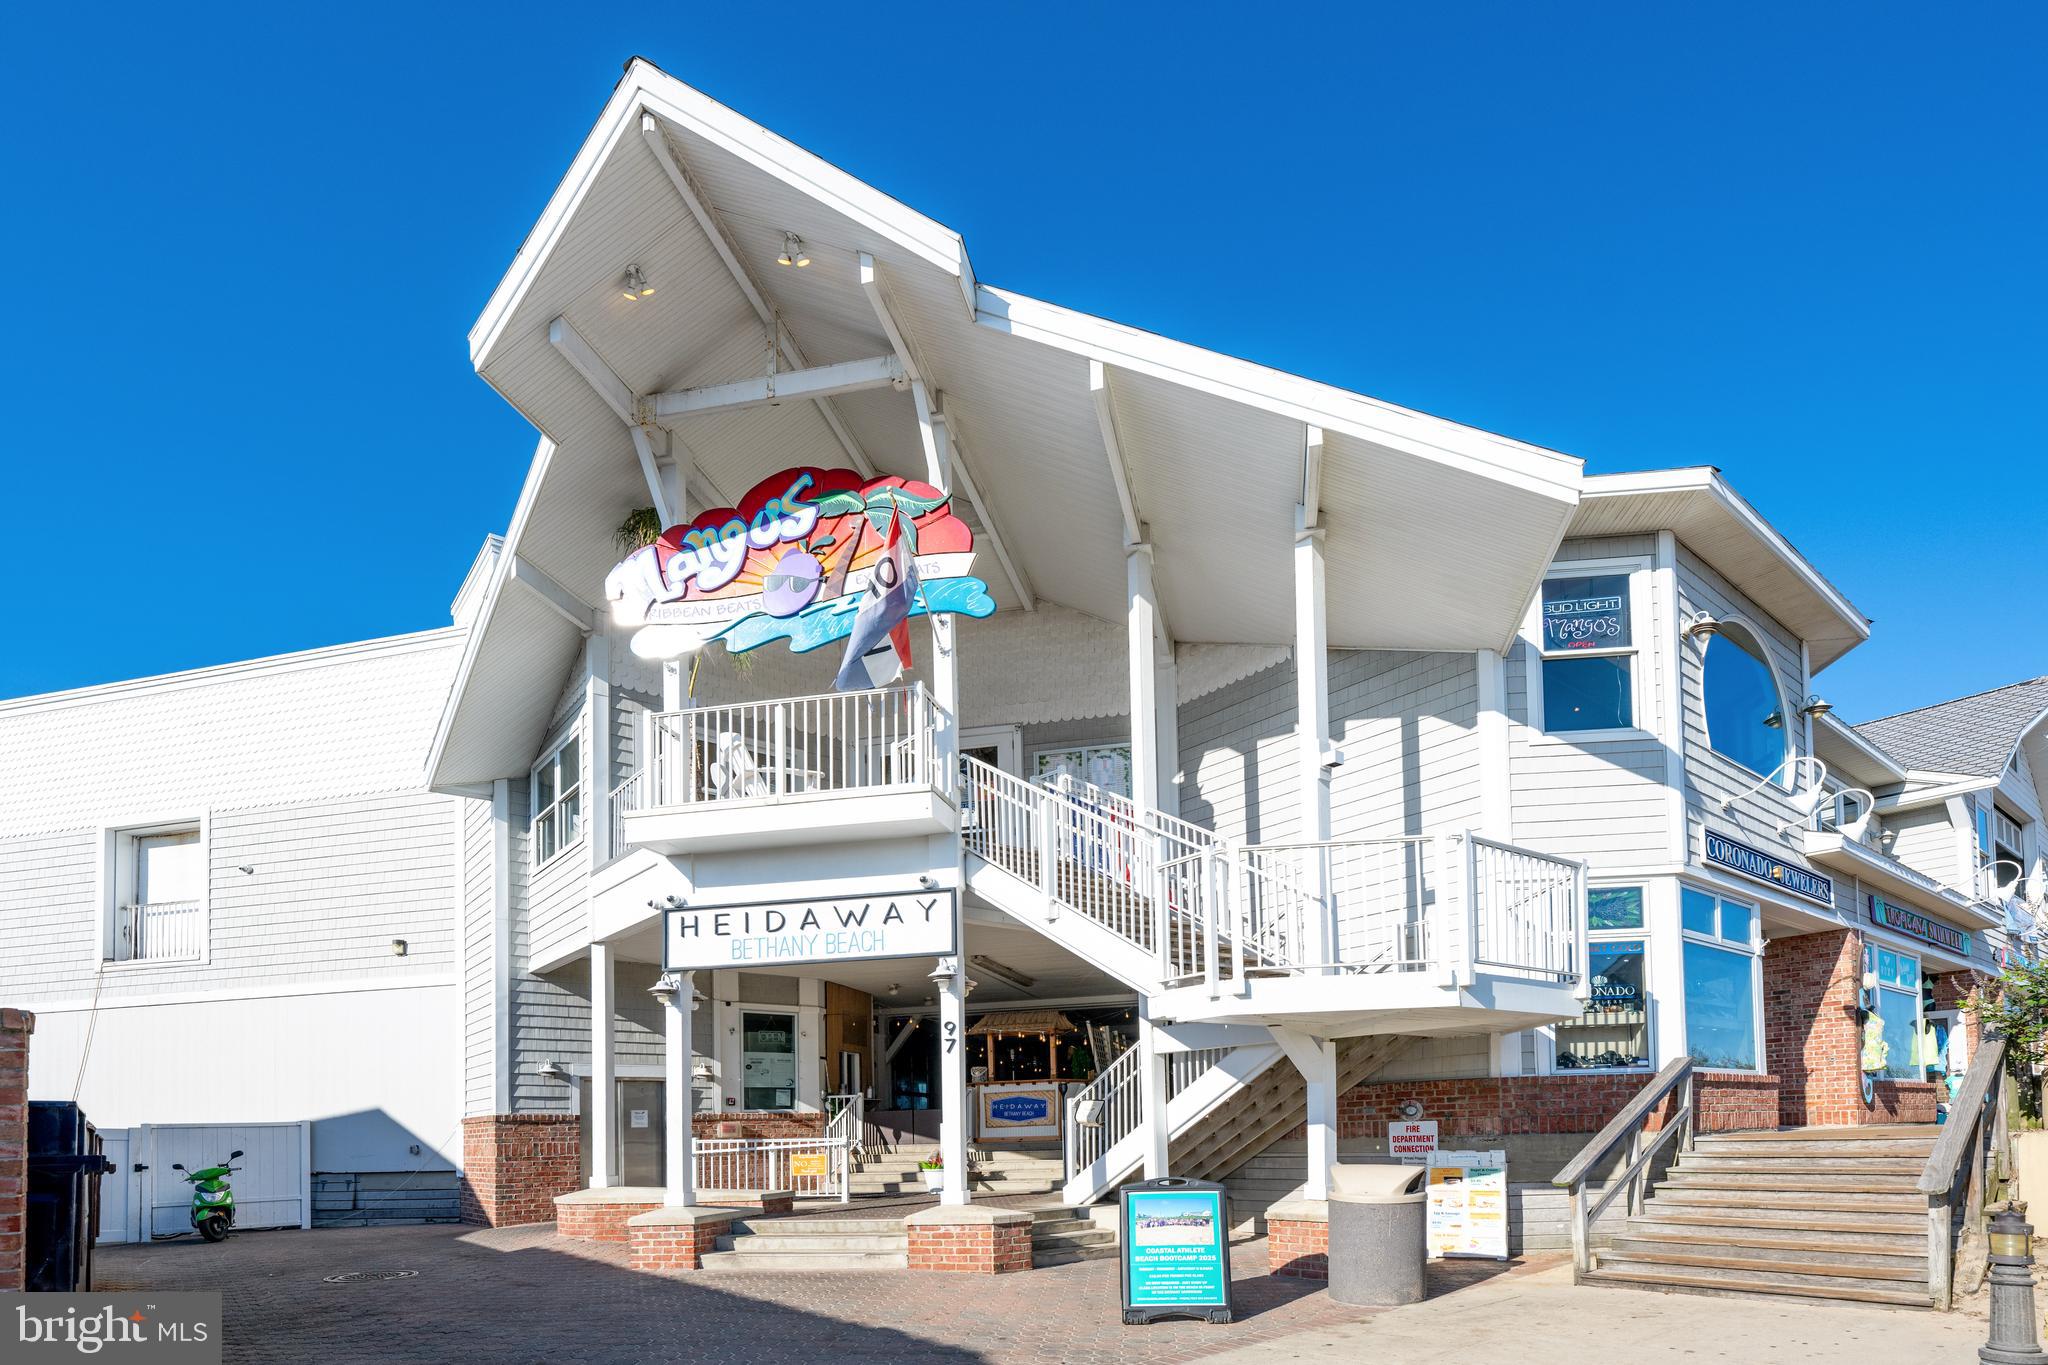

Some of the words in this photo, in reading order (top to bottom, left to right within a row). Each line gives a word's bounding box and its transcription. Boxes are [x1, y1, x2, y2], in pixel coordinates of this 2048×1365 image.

[717, 599, 762, 615] BEATS
[1575, 600, 1618, 611] LIGHT
[1567, 641, 1596, 649] OPEN
[1706, 836, 1774, 879] CORONADO
[1780, 866, 1829, 900] JEWELERS
[680, 898, 937, 938] HEIDAWAY
[731, 934, 818, 960] BETHANY
[825, 930, 884, 954] BEACH
[1591, 985, 1636, 997] ONADO
[760, 1032, 785, 1041] OPEN
[1405, 1125, 1421, 1133] FIRE
[1392, 1135, 1435, 1143] DEPARTMENT
[1393, 1145, 1435, 1153] CONNECTION
